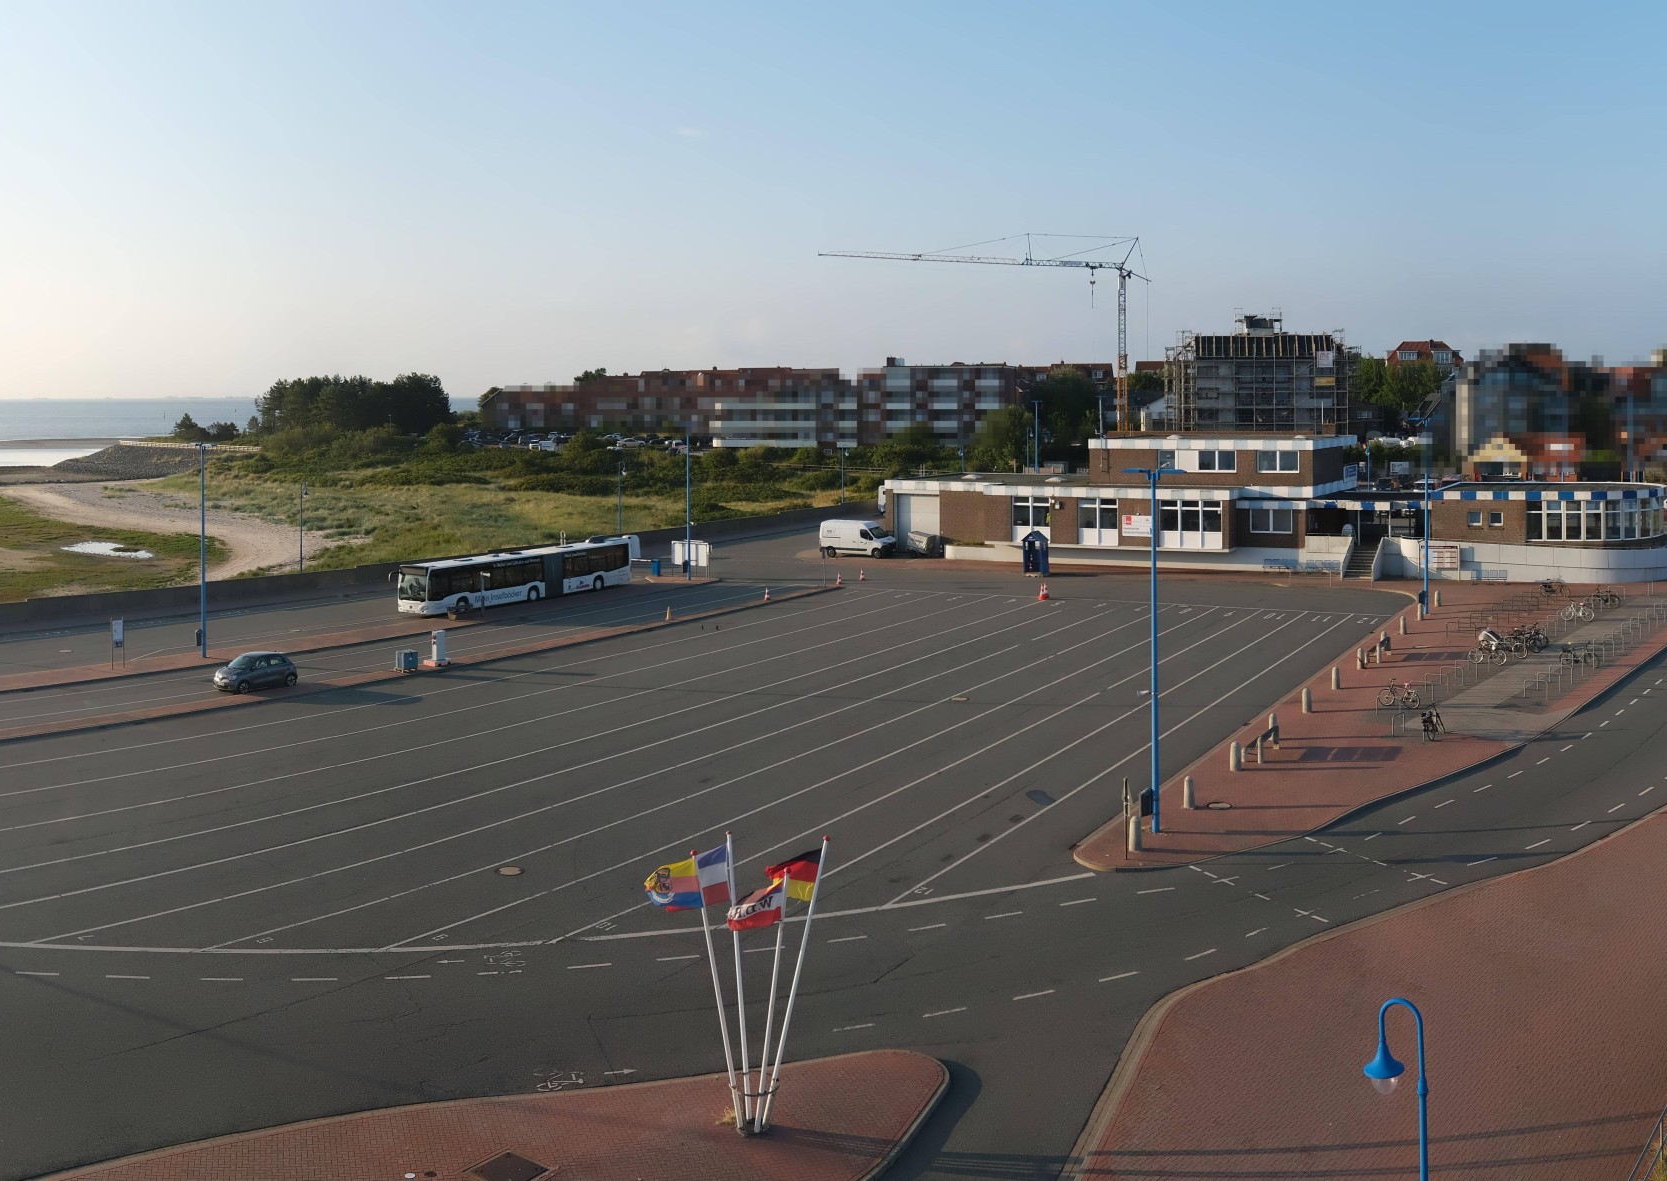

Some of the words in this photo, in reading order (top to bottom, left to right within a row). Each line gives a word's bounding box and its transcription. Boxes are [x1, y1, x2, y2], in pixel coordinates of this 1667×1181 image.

[1263, 612, 1286, 620] 10
[1356, 617, 1379, 625] 12
[914, 886, 933, 895] 12
